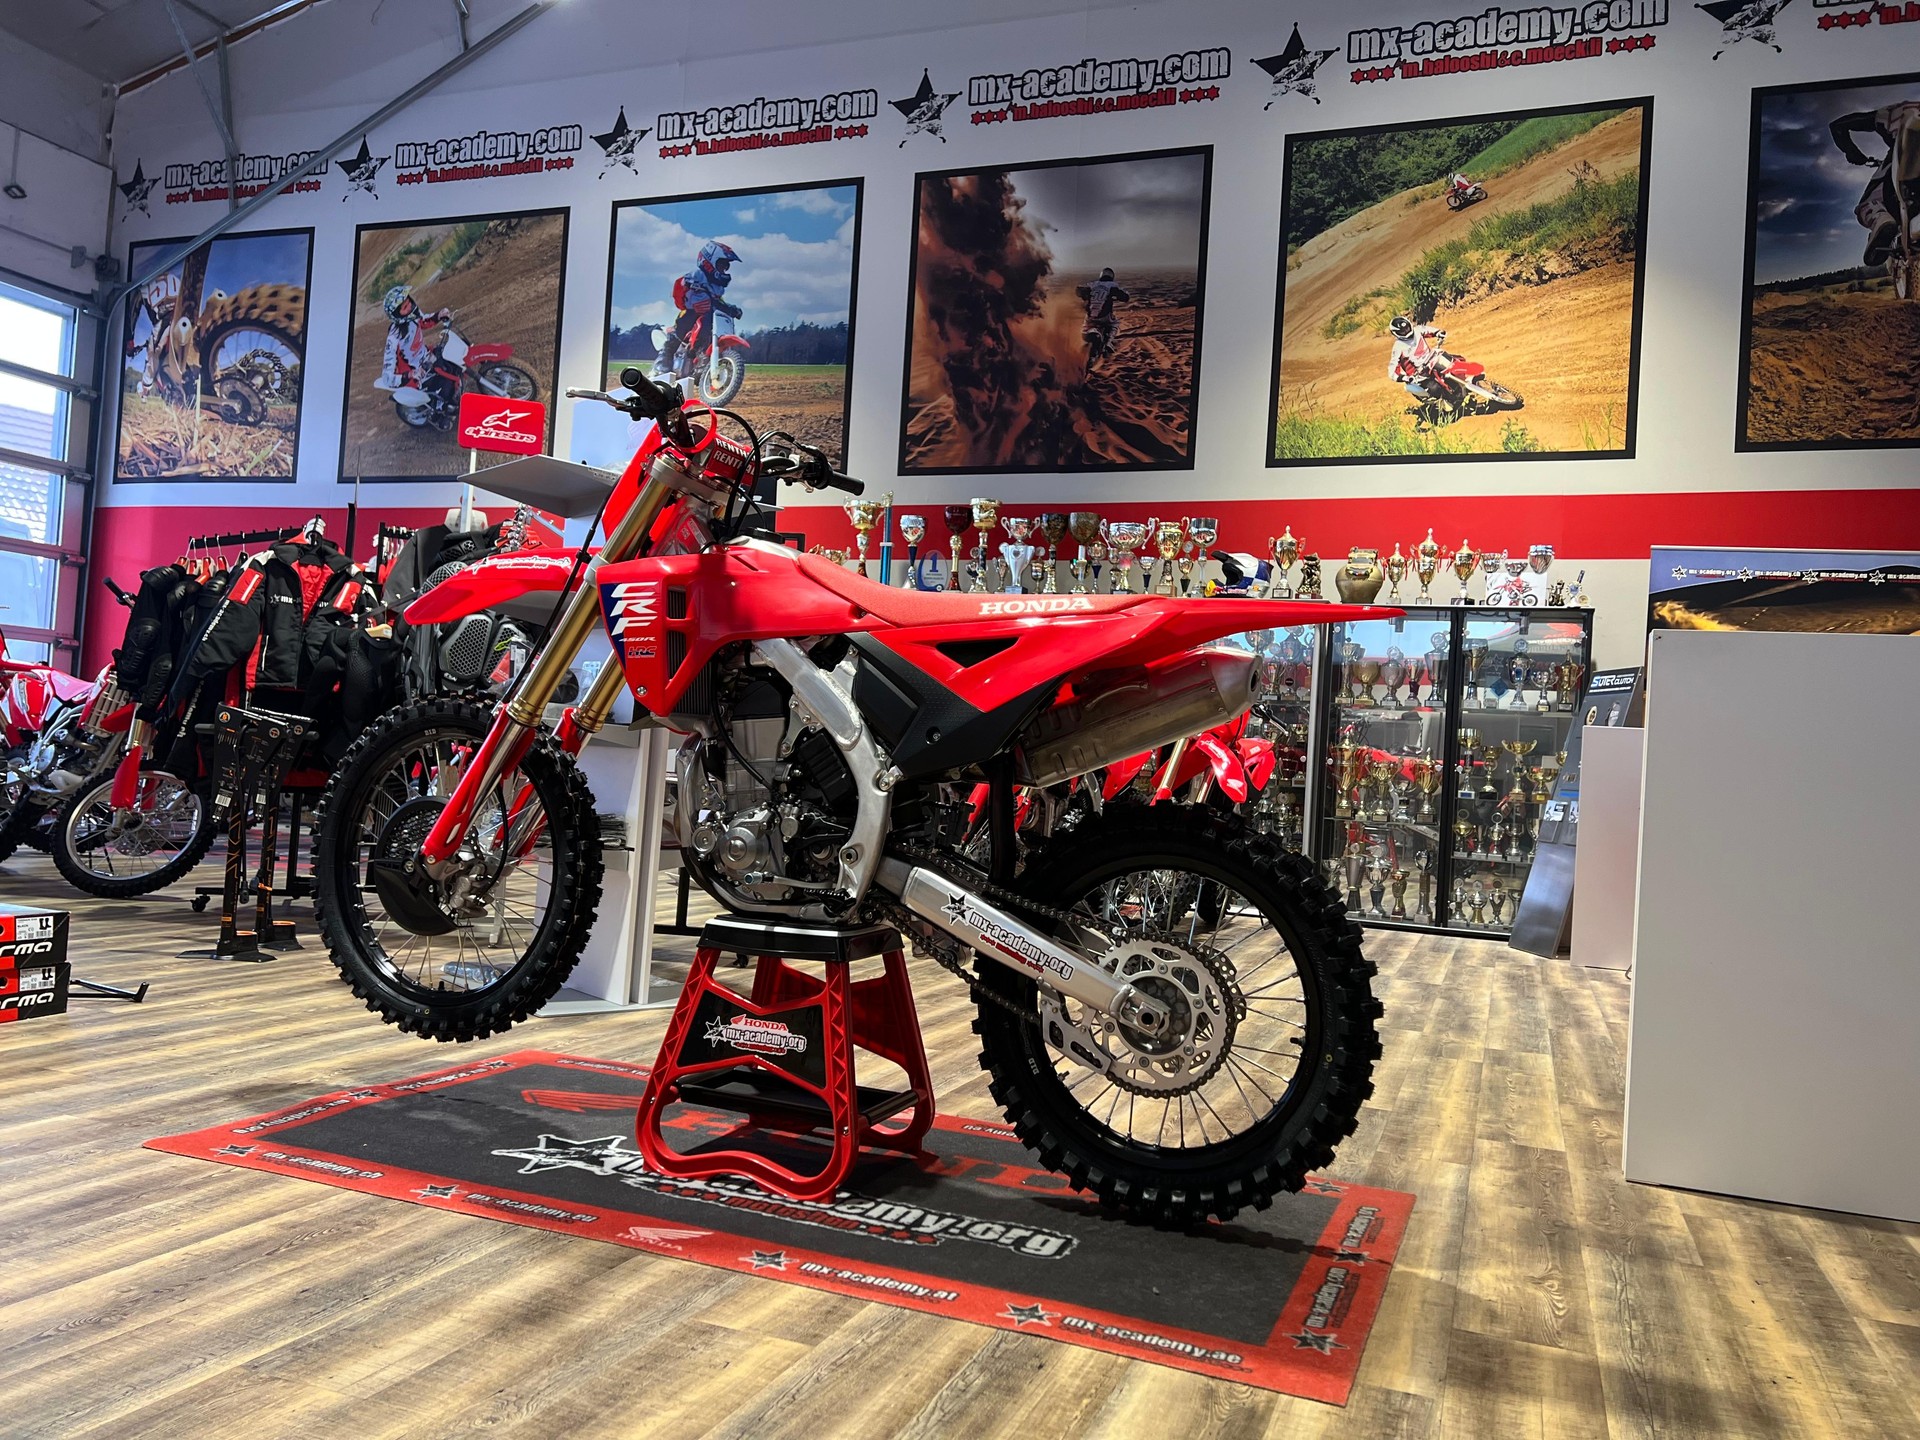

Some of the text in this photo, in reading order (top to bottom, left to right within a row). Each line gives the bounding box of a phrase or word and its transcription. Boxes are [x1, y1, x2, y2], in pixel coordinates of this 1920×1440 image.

[1347, 0, 1669, 63] mx-academy.com
[968, 47, 1231, 106] mx-academy.com
[657, 89, 878, 141] mx-academy.com
[395, 124, 582, 169] mx-academy.com
[609, 581, 659, 636] CRF
[979, 597, 1095, 615] HONDA
[969, 911, 1074, 981] mx-academy.org
[725, 1027, 806, 1051] mx-academy.org
[744, 1019, 788, 1031] HONDA
[466, 1192, 599, 1223] mx-academy.eu
[616, 1232, 683, 1251] HONDA
[800, 1260, 961, 1302] mx-academy.at
[1061, 1315, 1244, 1365] mx-academy.ae
